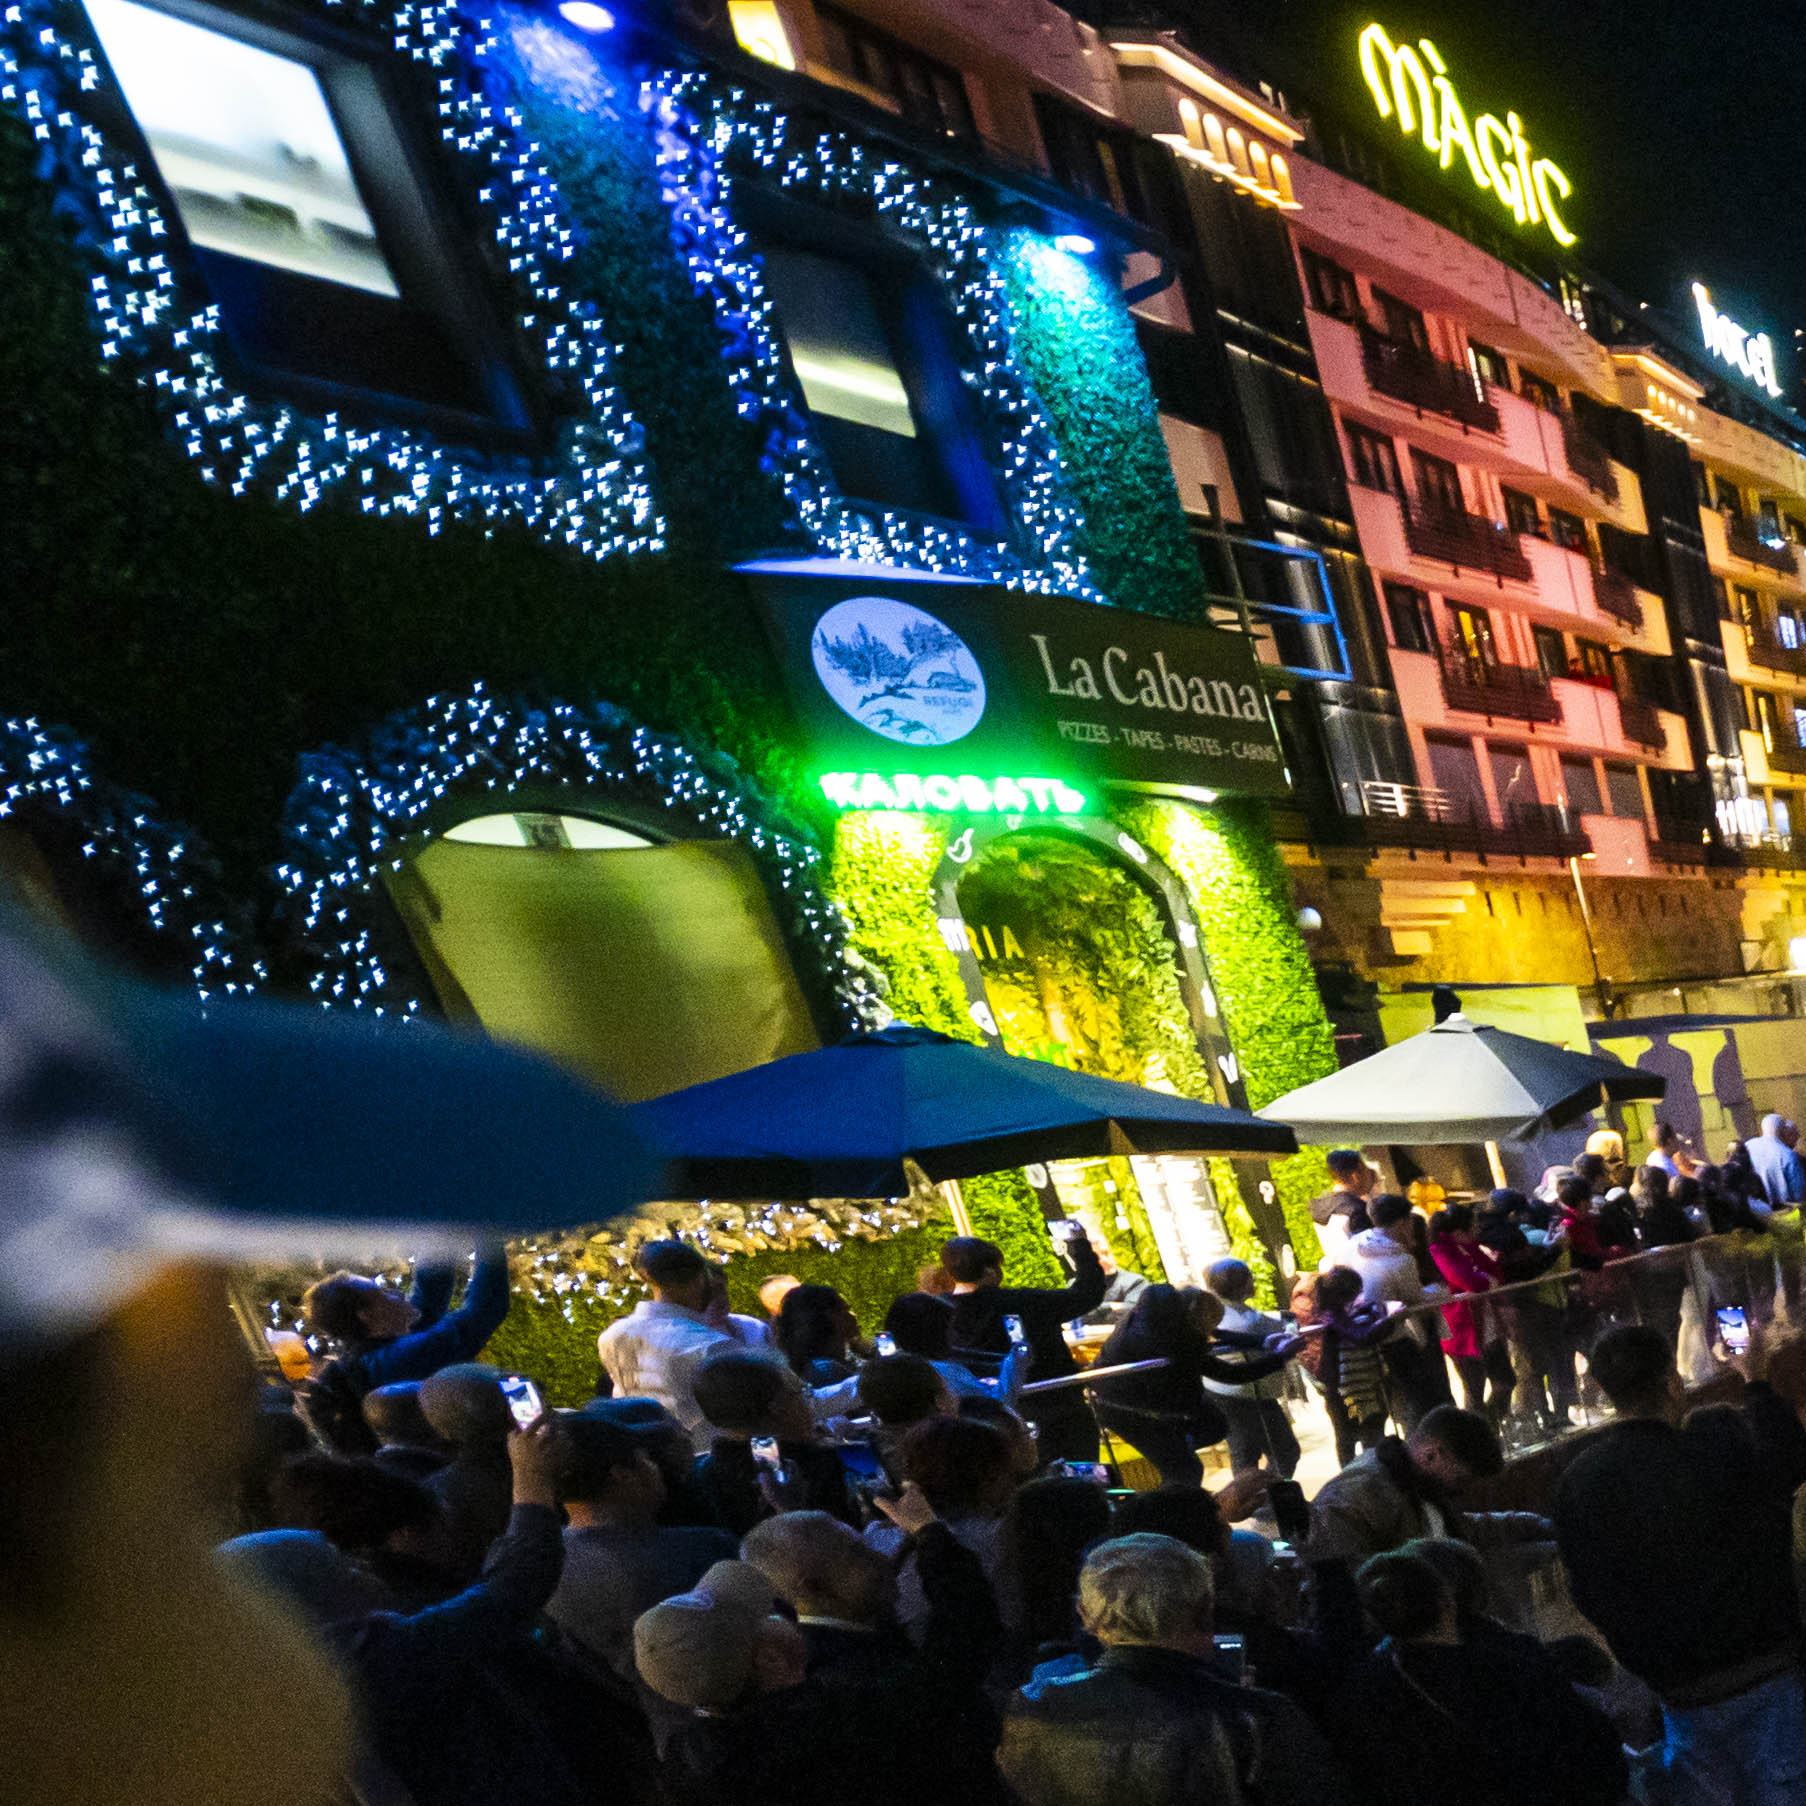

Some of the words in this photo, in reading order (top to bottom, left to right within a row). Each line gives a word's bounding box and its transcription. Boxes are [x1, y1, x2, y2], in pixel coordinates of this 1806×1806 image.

[1029, 633, 1102, 701] La
[1103, 645, 1266, 722] Cabana
[1119, 727, 1165, 751] TAPES
